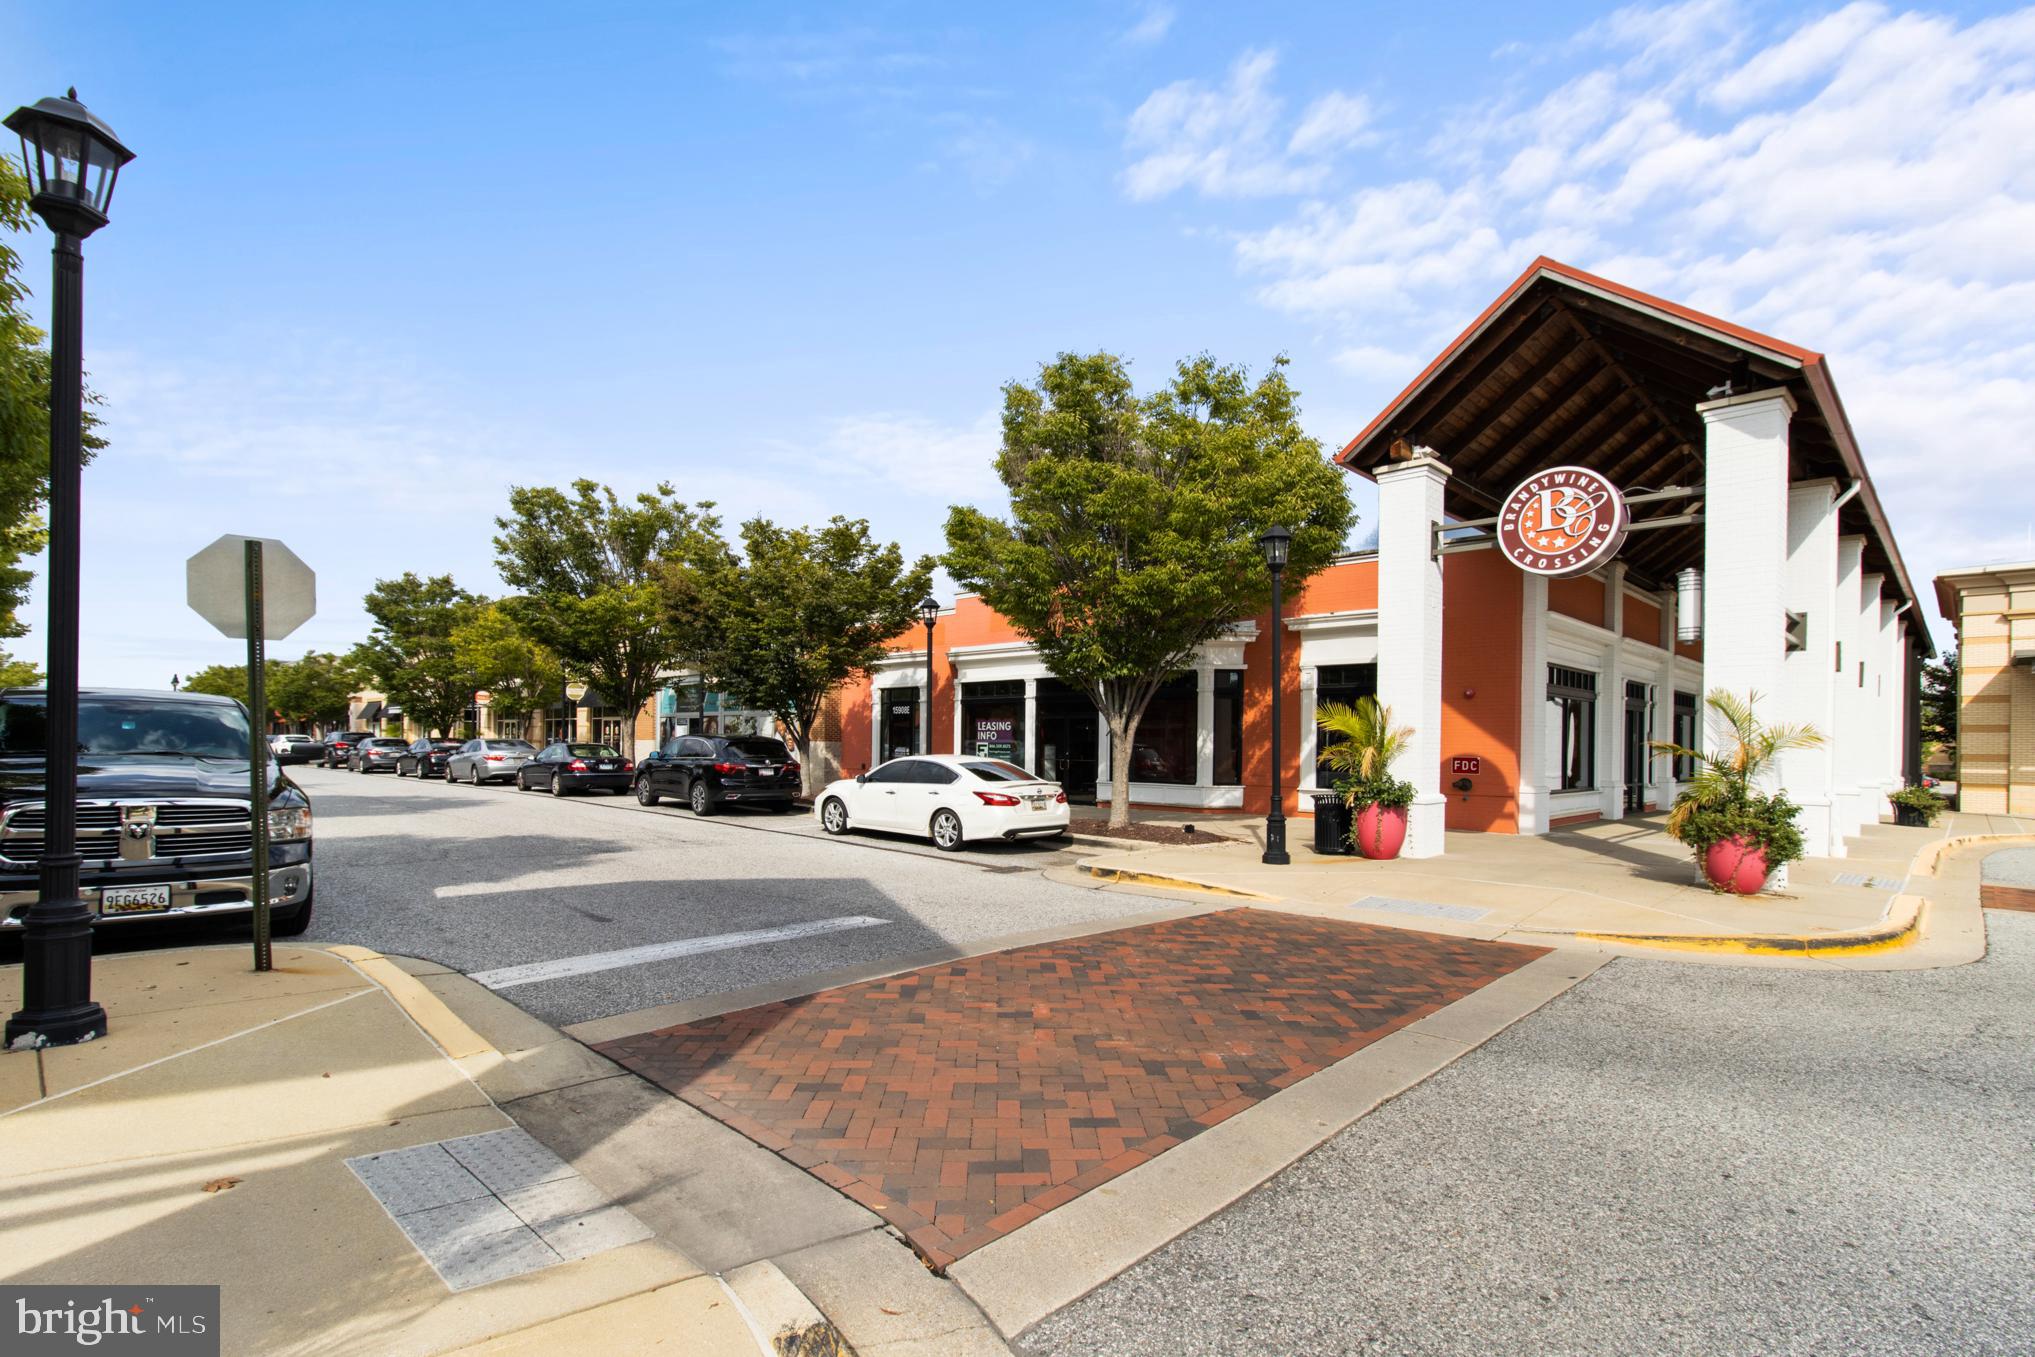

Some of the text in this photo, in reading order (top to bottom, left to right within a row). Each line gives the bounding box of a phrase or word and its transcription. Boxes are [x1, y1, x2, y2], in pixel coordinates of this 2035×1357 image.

[1504, 473, 1599, 531] BRANDYWINE
[1513, 523, 1610, 568] CROSSING
[977, 721, 1012, 731] LEASING
[977, 731, 997, 740] INFO
[1454, 760, 1477, 771] FDC
